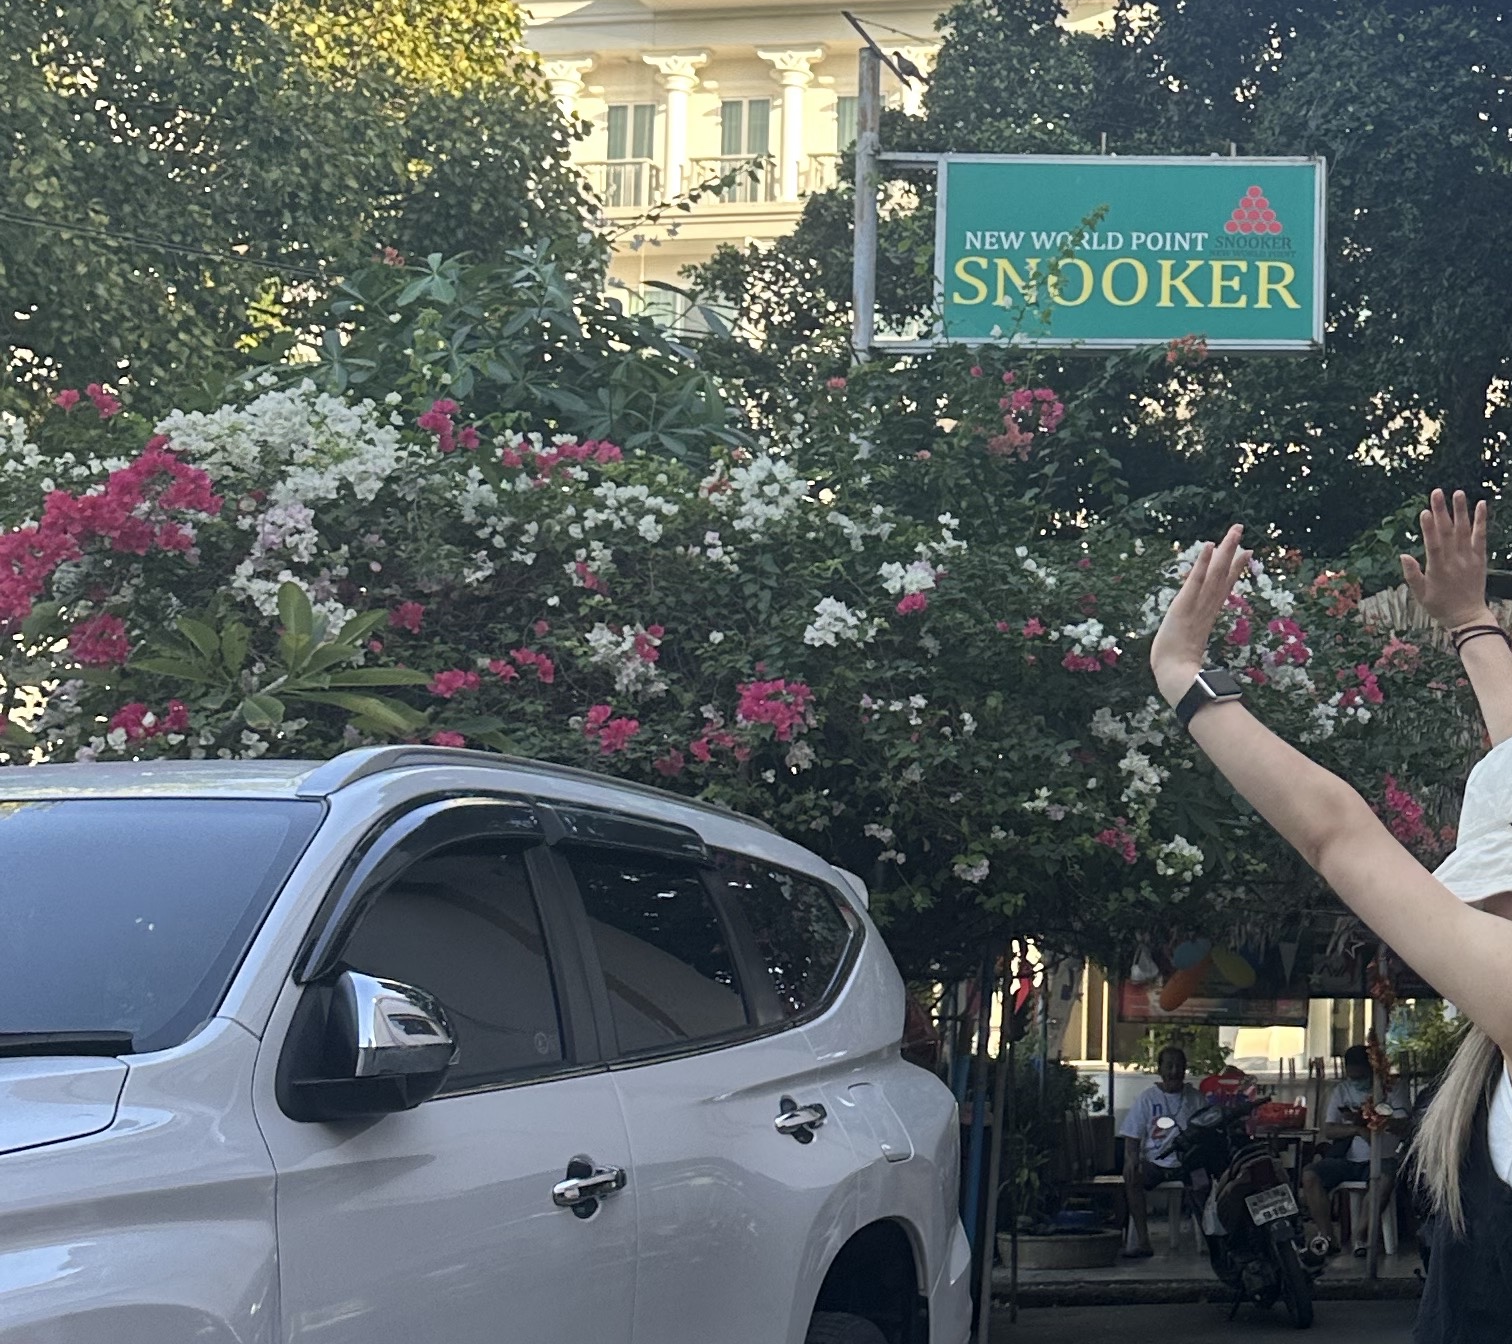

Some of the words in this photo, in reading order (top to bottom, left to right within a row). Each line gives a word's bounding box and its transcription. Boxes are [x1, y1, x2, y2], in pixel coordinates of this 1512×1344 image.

[964, 230, 1026, 251] NEW
[1031, 231, 1124, 251] WORLD
[1130, 231, 1209, 252] POINT
[1214, 235, 1292, 250] SNOOKER
[952, 256, 1302, 309] SNOOKER
